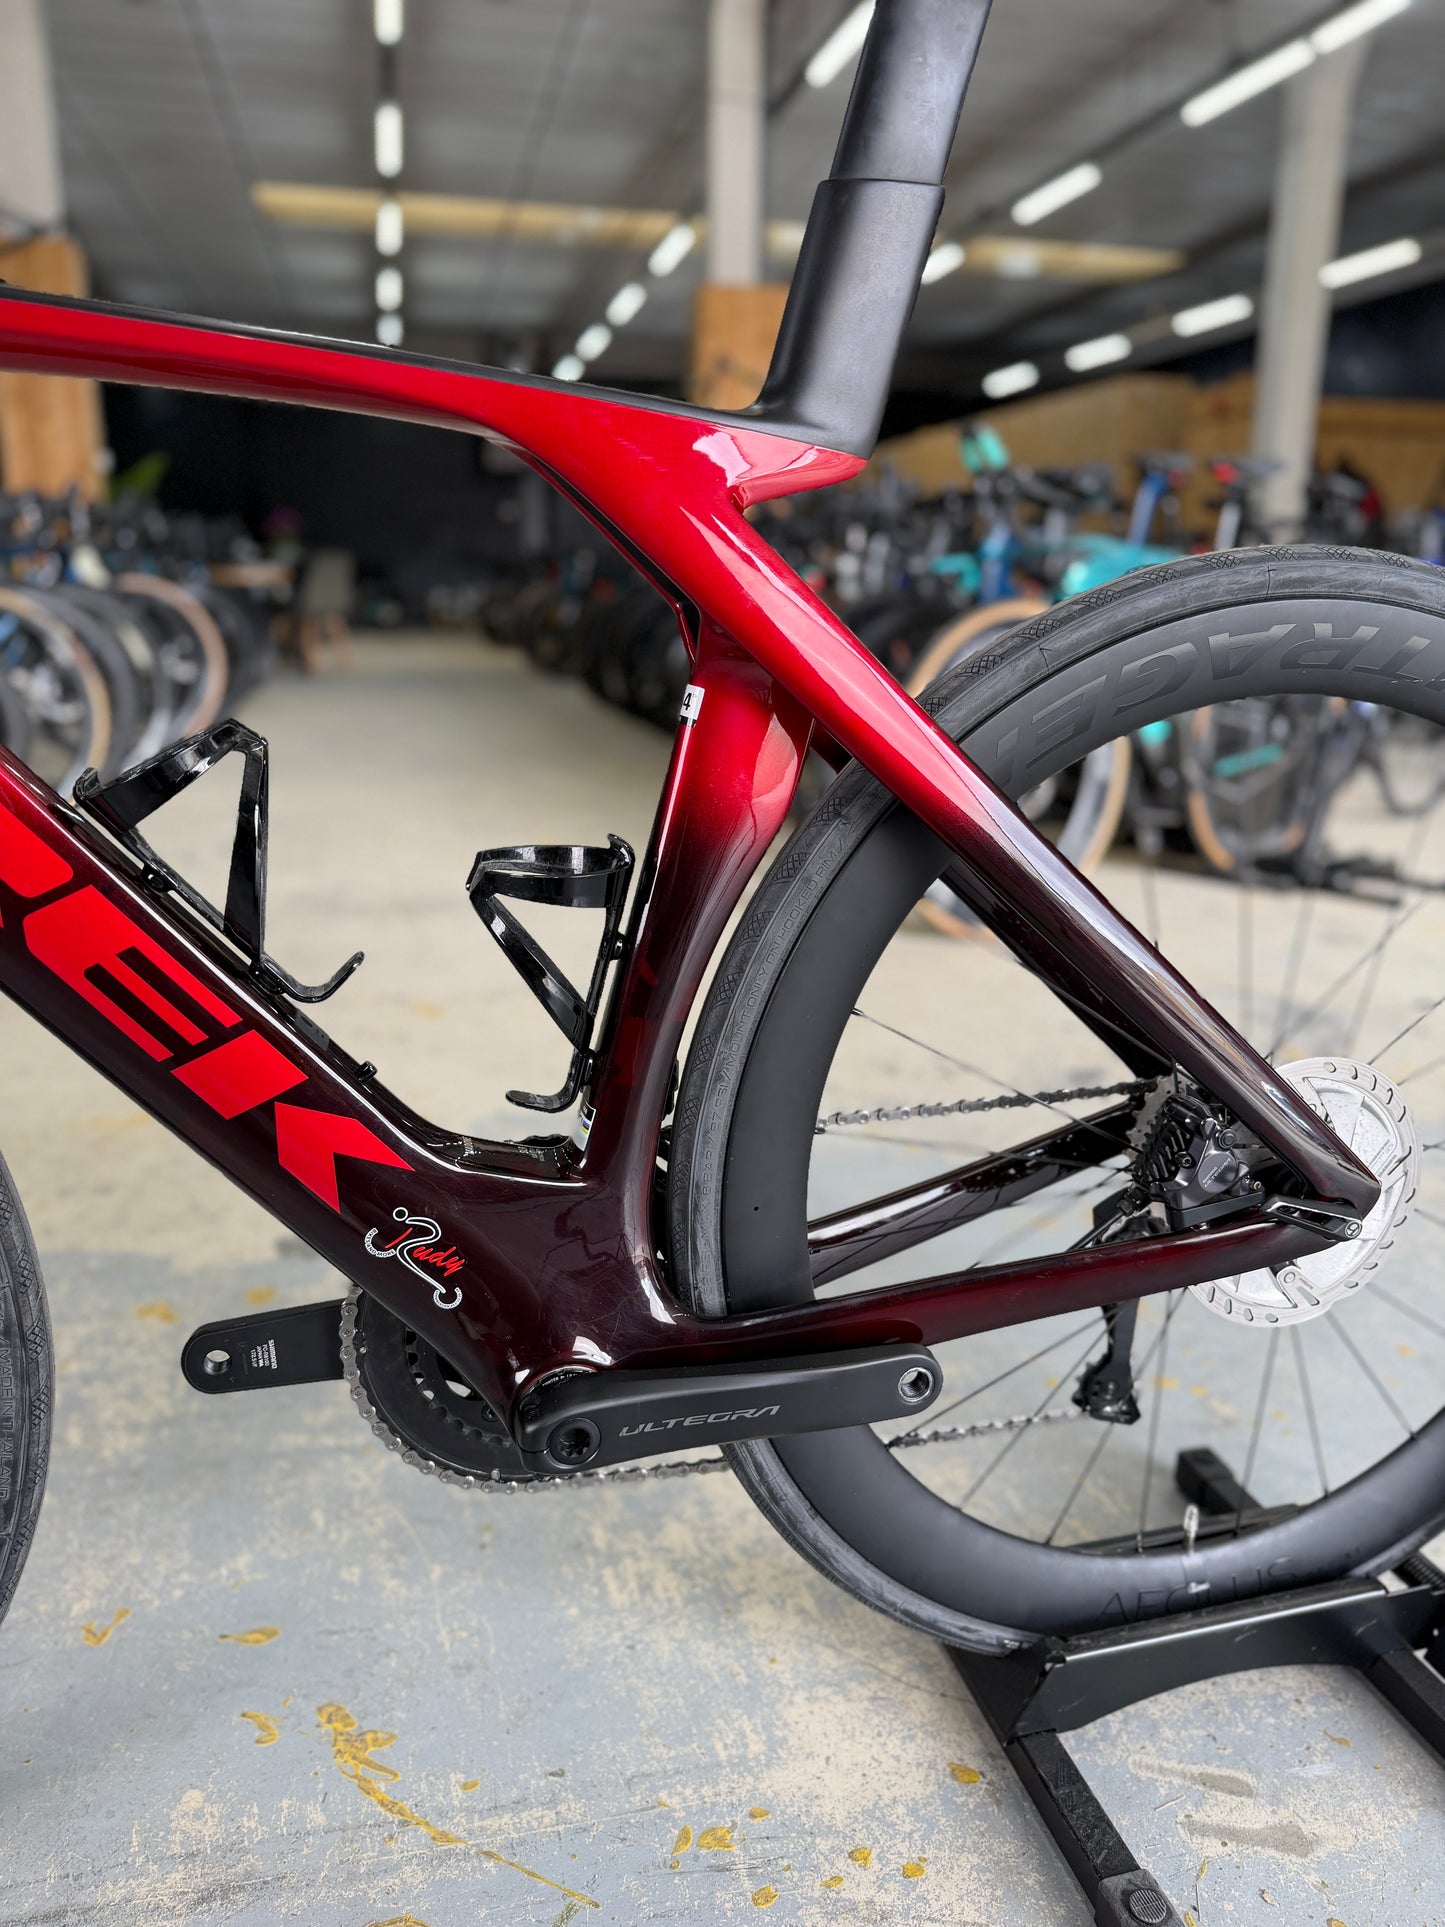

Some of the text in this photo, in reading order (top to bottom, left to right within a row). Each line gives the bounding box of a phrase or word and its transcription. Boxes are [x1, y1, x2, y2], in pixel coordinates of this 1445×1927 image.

[683, 692, 692, 711] 4
[725, 1009, 751, 1067] MOUNT
[747, 966, 767, 1008] ONLY
[765, 941, 781, 964] ON
[777, 878, 818, 941] HOOKED
[815, 849, 838, 879] RIM
[0, 1348, 13, 1398] MADE
[2, 1401, 13, 1416] IN
[619, 1405, 781, 1437] ULTEGRA
[0, 1417, 14, 1499] THAILAND
